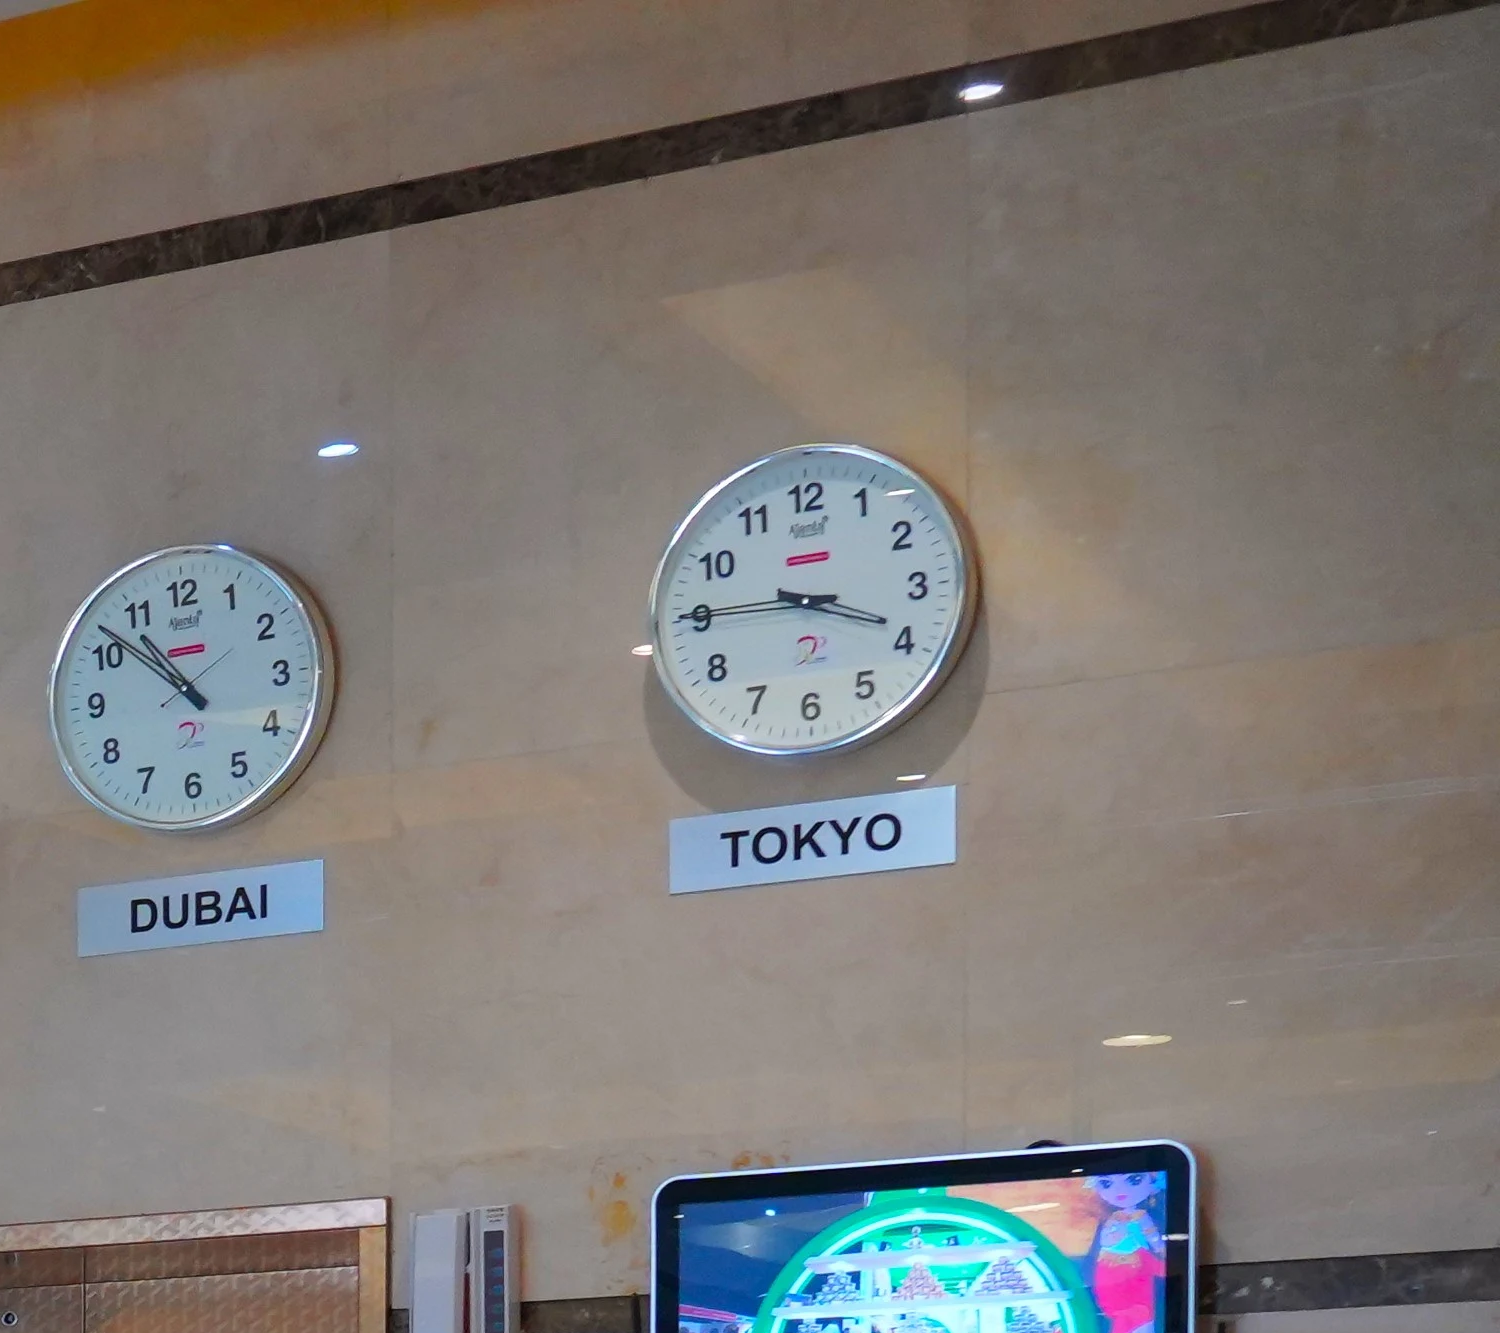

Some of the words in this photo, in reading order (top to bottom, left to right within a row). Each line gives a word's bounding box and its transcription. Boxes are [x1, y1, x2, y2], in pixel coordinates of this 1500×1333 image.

[788, 482, 824, 513] 12
[854, 488, 867, 517] 1
[738, 505, 769, 536] 11
[892, 521, 912, 550] 2
[700, 550, 734, 580] 10
[167, 579, 198, 608] 12
[224, 584, 236, 610] 1
[908, 572, 928, 600] 3
[125, 600, 150, 629] 11
[258, 613, 275, 640] 2
[693, 604, 711, 631] 9
[895, 626, 914, 654] 4
[92, 642, 123, 670] 10
[708, 654, 727, 681] 8
[273, 659, 289, 686] 3
[856, 670, 875, 699] 5
[88, 692, 105, 718] 9
[747, 686, 767, 715] 7
[802, 692, 821, 720] 6
[263, 709, 280, 736] 4
[103, 737, 120, 763] 8
[231, 751, 248, 778] 5
[137, 766, 155, 794] 7
[185, 773, 202, 798] 6
[721, 813, 901, 868] TOKYO
[131, 884, 268, 933] DUBAI
